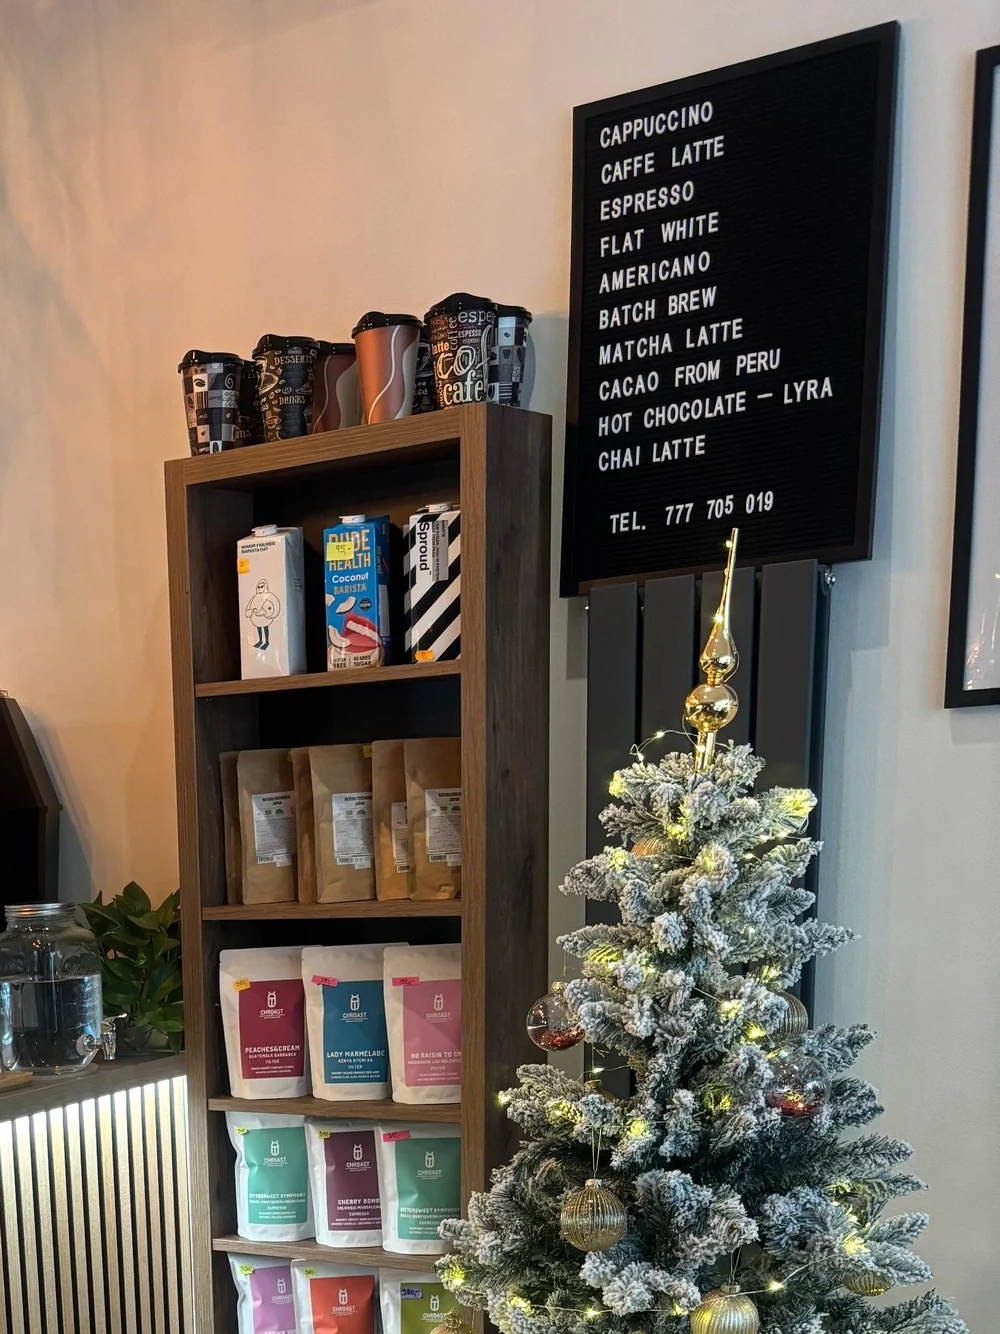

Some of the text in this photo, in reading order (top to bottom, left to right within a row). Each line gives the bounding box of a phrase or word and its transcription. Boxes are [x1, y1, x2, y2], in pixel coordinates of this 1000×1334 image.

[599, 101, 714, 149] CAPPUCCINO
[601, 136, 724, 184] CAFFE LATTE
[600, 181, 694, 221] ESPRESSO
[601, 212, 718, 257] FLAT WHITE
[599, 251, 710, 294] AMERICANO
[600, 286, 716, 329] BATCH BREW
[274, 355, 312, 365] DESSERTS
[432, 341, 449, 355] latte
[599, 319, 742, 365] MATCHA LATTE
[599, 348, 780, 401] CACAO FROM PERU
[279, 396, 306, 405] DRINKS
[599, 412, 632, 436] HOT
[643, 391, 746, 428] CHOCOLATE
[784, 377, 832, 404] LYRA
[599, 435, 705, 471] CHAI LATTE
[610, 491, 773, 533] TEL. 777 705 019
[417, 522, 430, 571] Sproud
[332, 572, 369, 583] Coconut
[334, 584, 367, 595] BARISTA
[245, 1045, 300, 1053] PEACHES&CREAM
